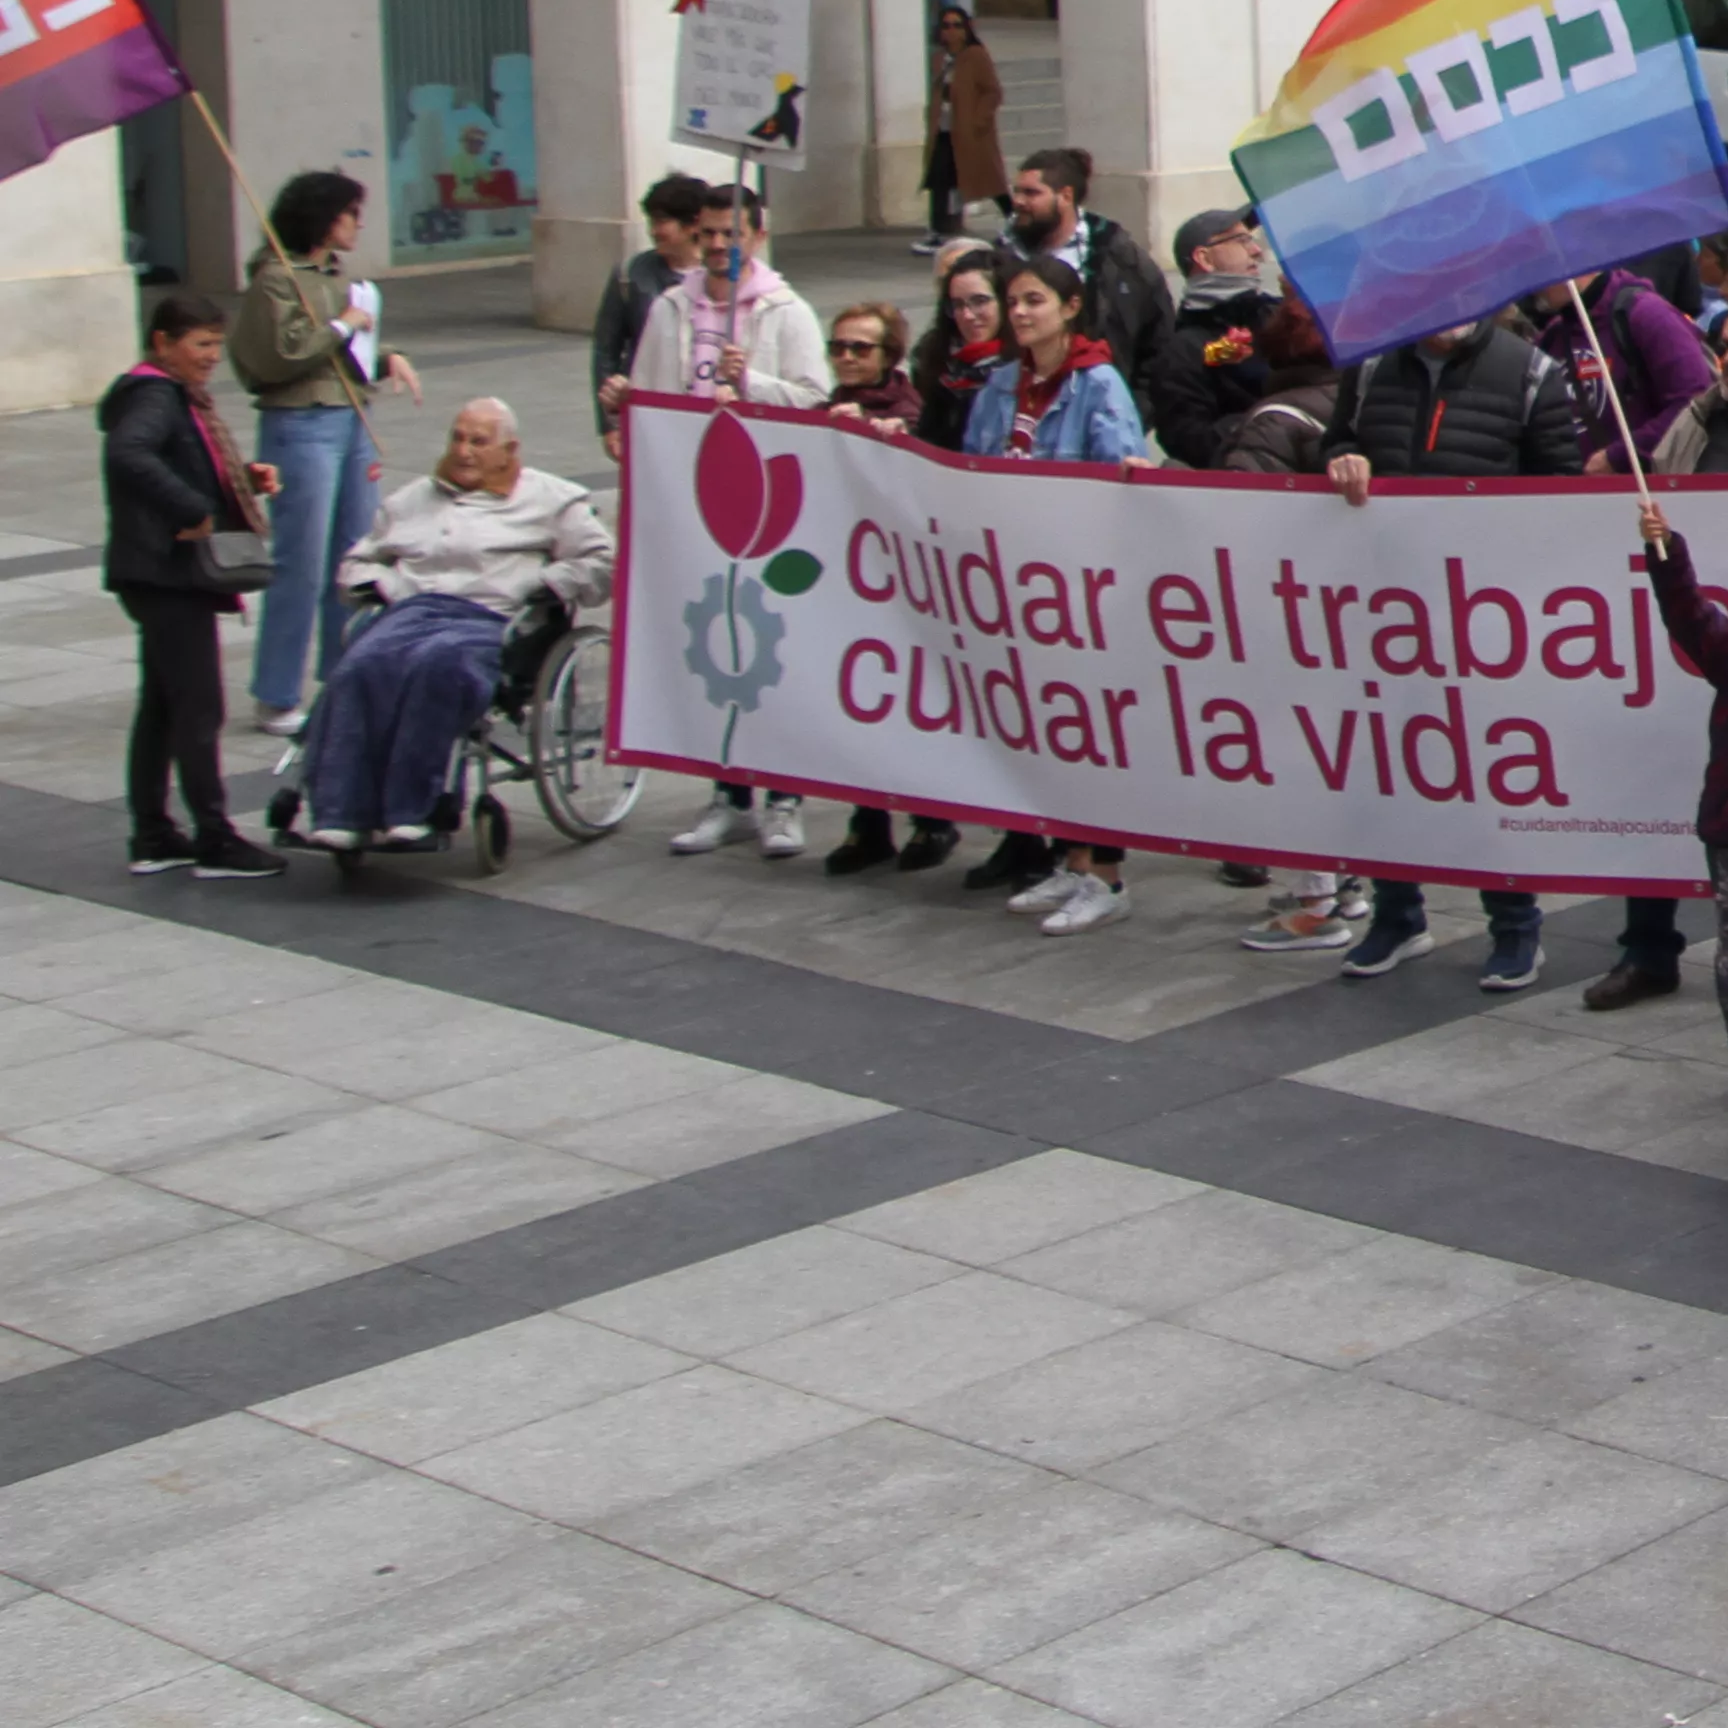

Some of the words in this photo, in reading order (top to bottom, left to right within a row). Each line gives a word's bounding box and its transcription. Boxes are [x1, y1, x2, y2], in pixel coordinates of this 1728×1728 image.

[847, 516, 1115, 651] cuidar
[1149, 546, 1246, 663] el
[839, 636, 1138, 770] cuidar
[1166, 665, 1273, 787] la
[1294, 683, 1568, 807] vida
